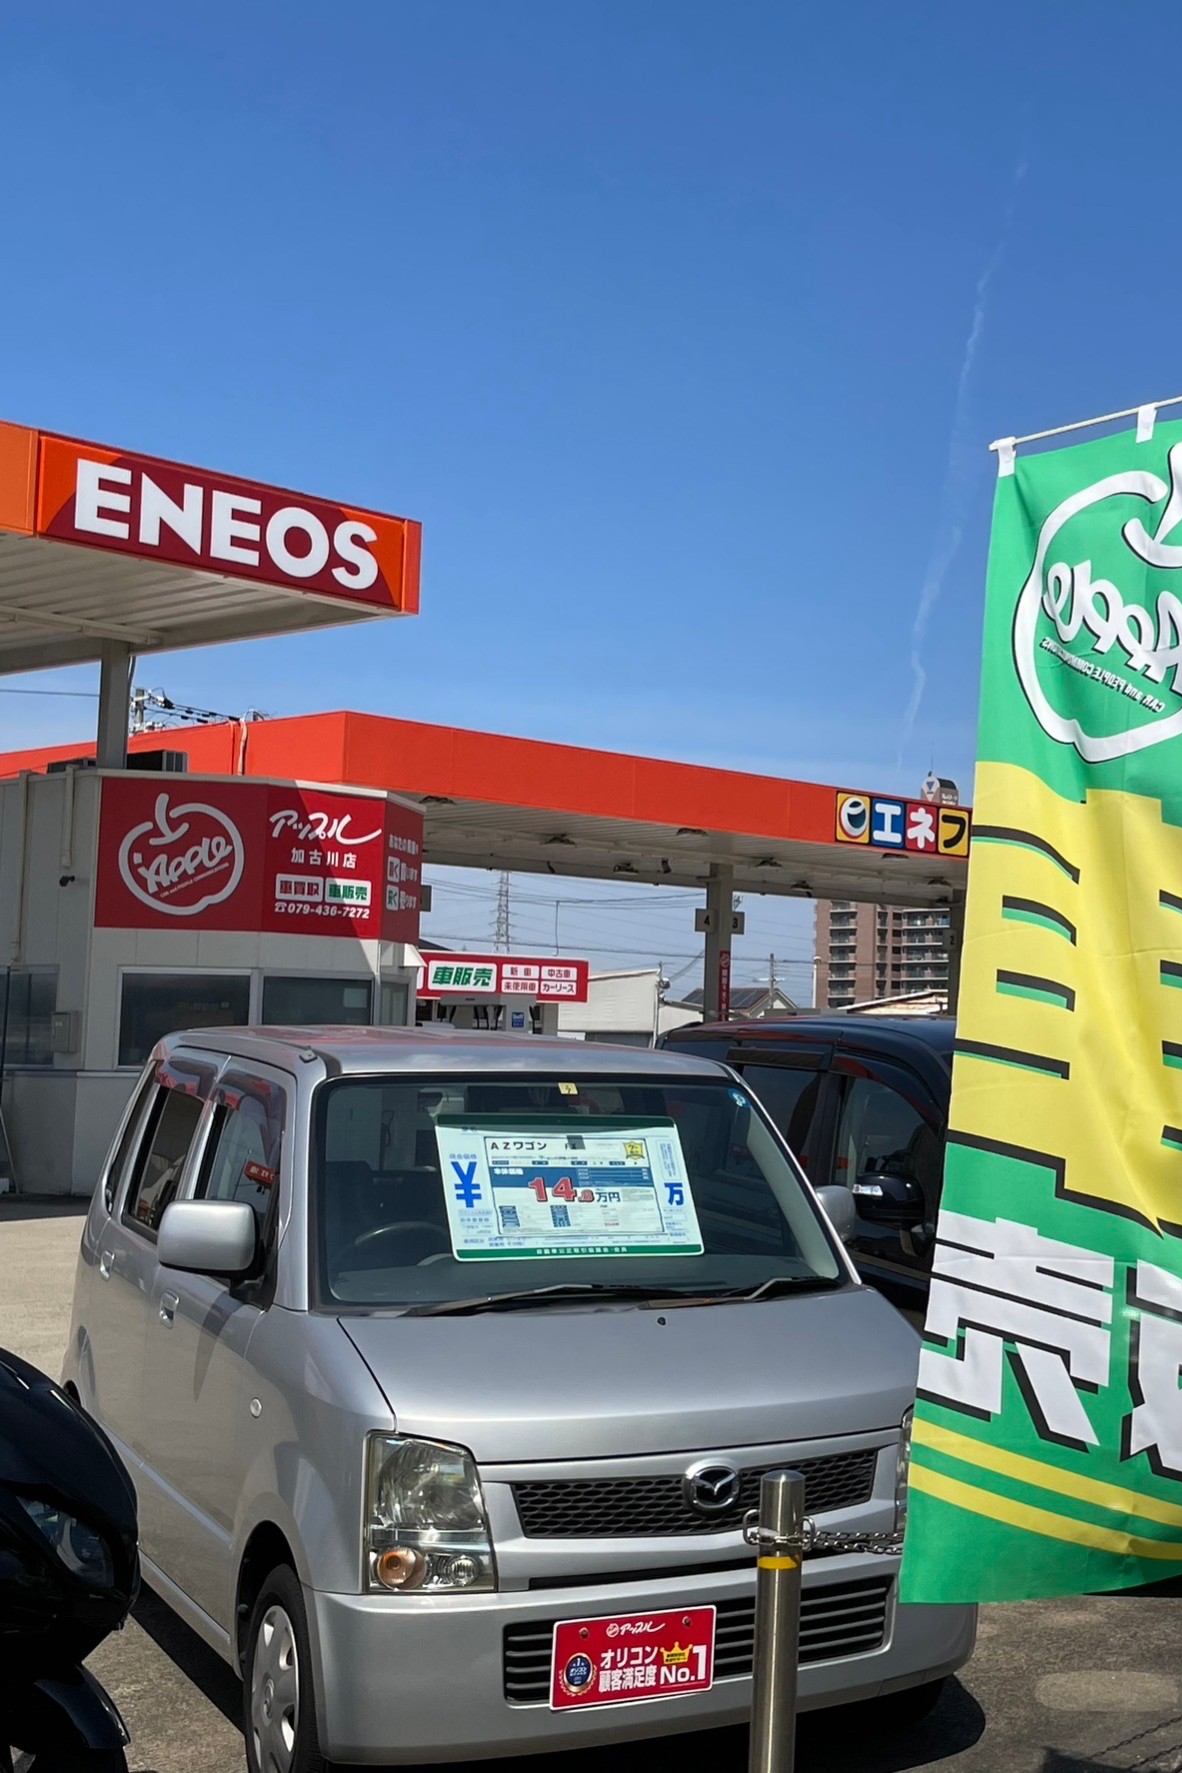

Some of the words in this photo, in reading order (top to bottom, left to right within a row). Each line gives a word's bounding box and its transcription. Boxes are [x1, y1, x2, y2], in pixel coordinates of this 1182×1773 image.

[74, 458, 379, 590] ENEOS
[269, 809, 382, 845] アップル
[291, 848, 357, 869] 加古川店
[329, 884, 368, 900] 車販売
[288, 903, 370, 919] 079-436-7272
[733, 917, 739, 929] 3
[432, 966, 493, 987] 車販売
[547, 969, 571, 979] 中古車
[503, 981, 536, 992] 未使用車
[542, 983, 575, 993] カーリース
[451, 1161, 482, 1208] ¥
[664, 1182, 684, 1206] 万
[600, 1646, 658, 1669] オリコン
[660, 1645, 707, 1685] No.1
[598, 1665, 657, 1693] 顧客満足度
